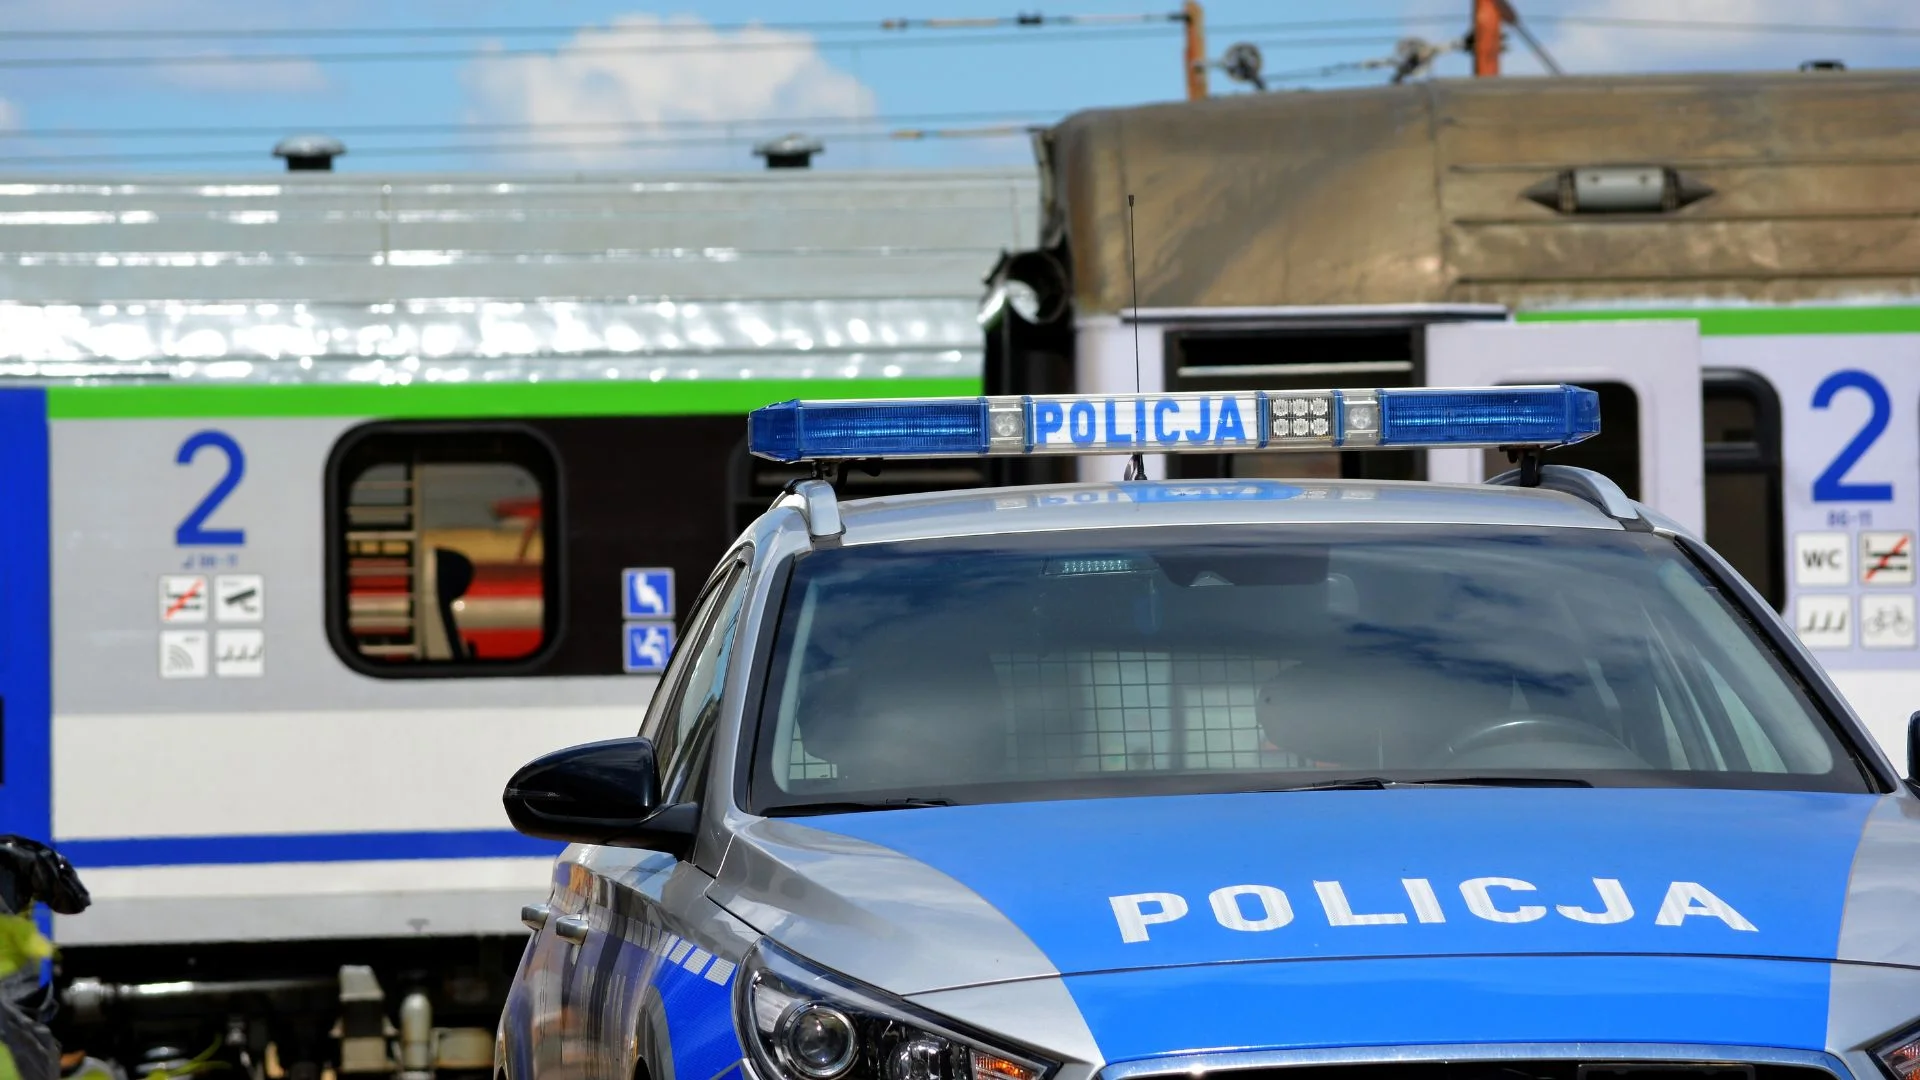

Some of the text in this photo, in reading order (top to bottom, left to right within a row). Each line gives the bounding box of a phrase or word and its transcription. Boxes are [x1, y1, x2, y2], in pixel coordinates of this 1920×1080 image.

[1035, 395, 1247, 448] POLICJA
[1811, 369, 1893, 502] 2
[175, 430, 246, 546] 2
[1803, 549, 1841, 569] WC
[1109, 876, 1759, 943] POLICJA
